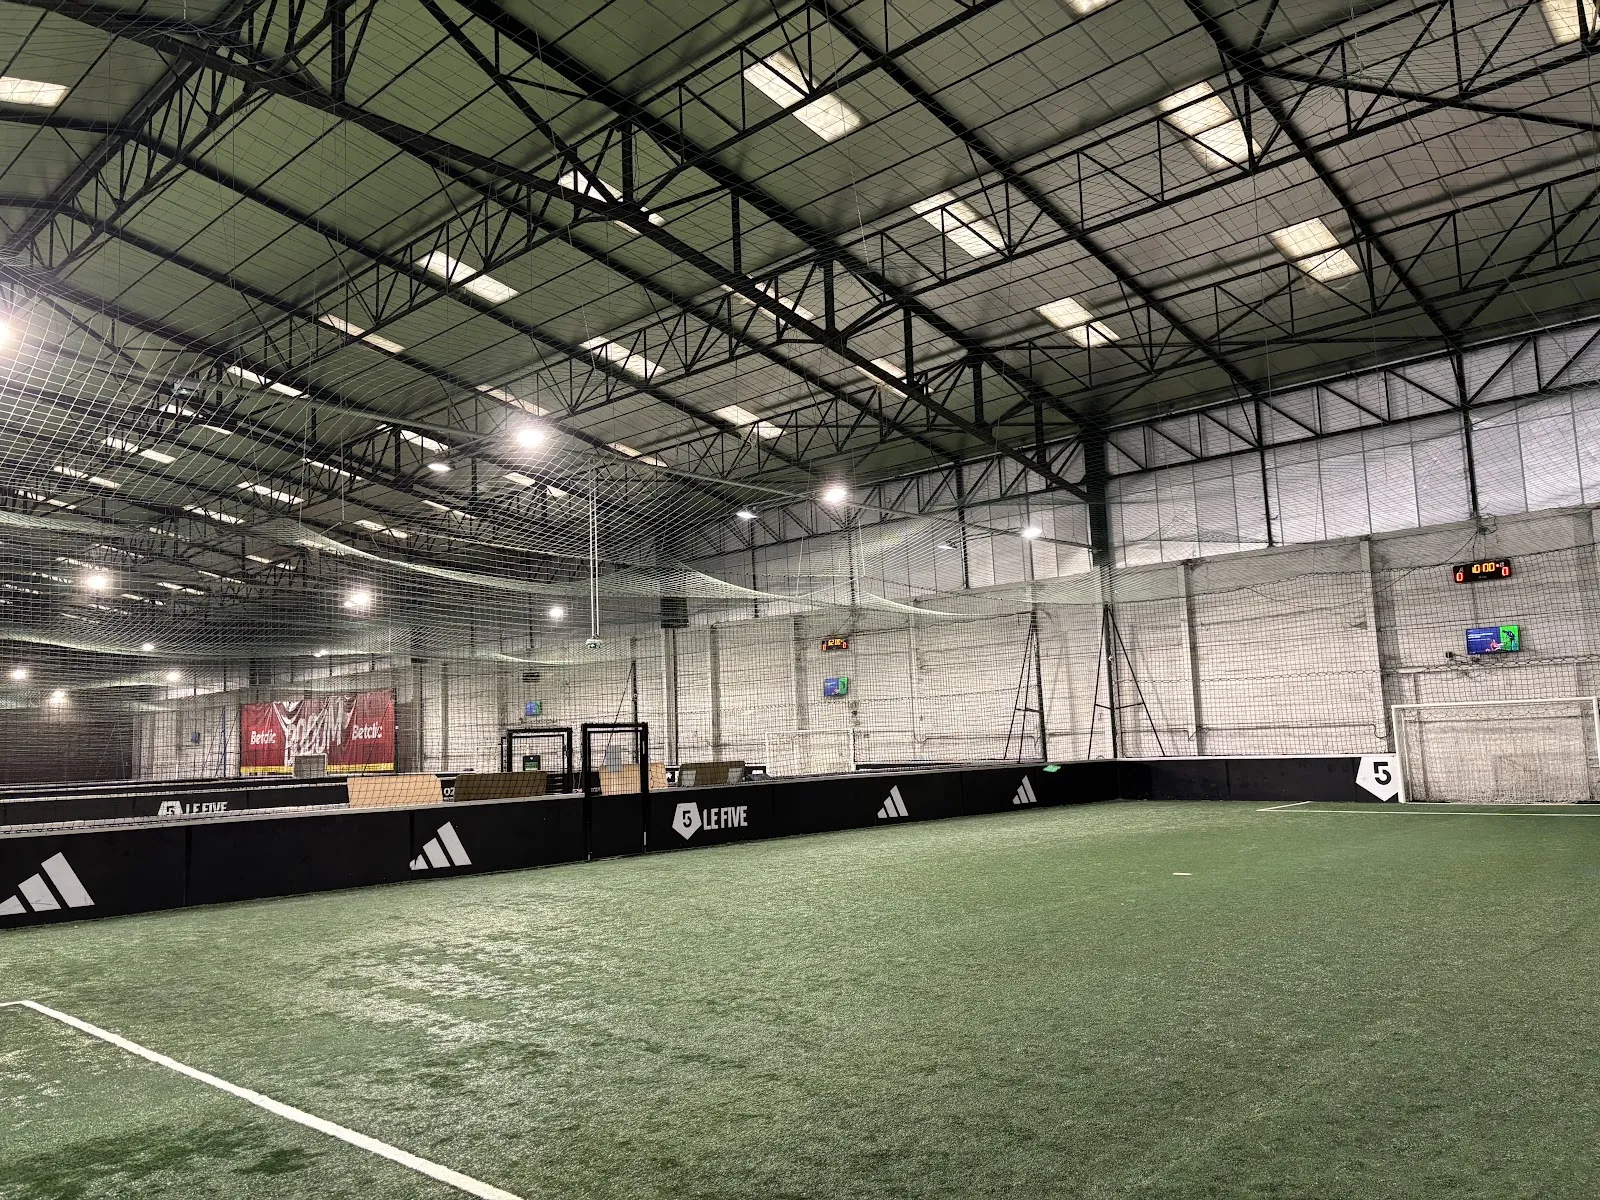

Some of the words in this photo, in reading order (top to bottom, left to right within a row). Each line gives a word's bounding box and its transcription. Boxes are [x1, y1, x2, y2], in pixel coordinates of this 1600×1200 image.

[1456, 572, 1463, 581] 0
[1502, 567, 1509, 576] 0
[352, 721, 383, 740] Betclic
[1373, 761, 1392, 785] 5
[703, 808, 719, 830] LE
[721, 805, 748, 829] FIVE
